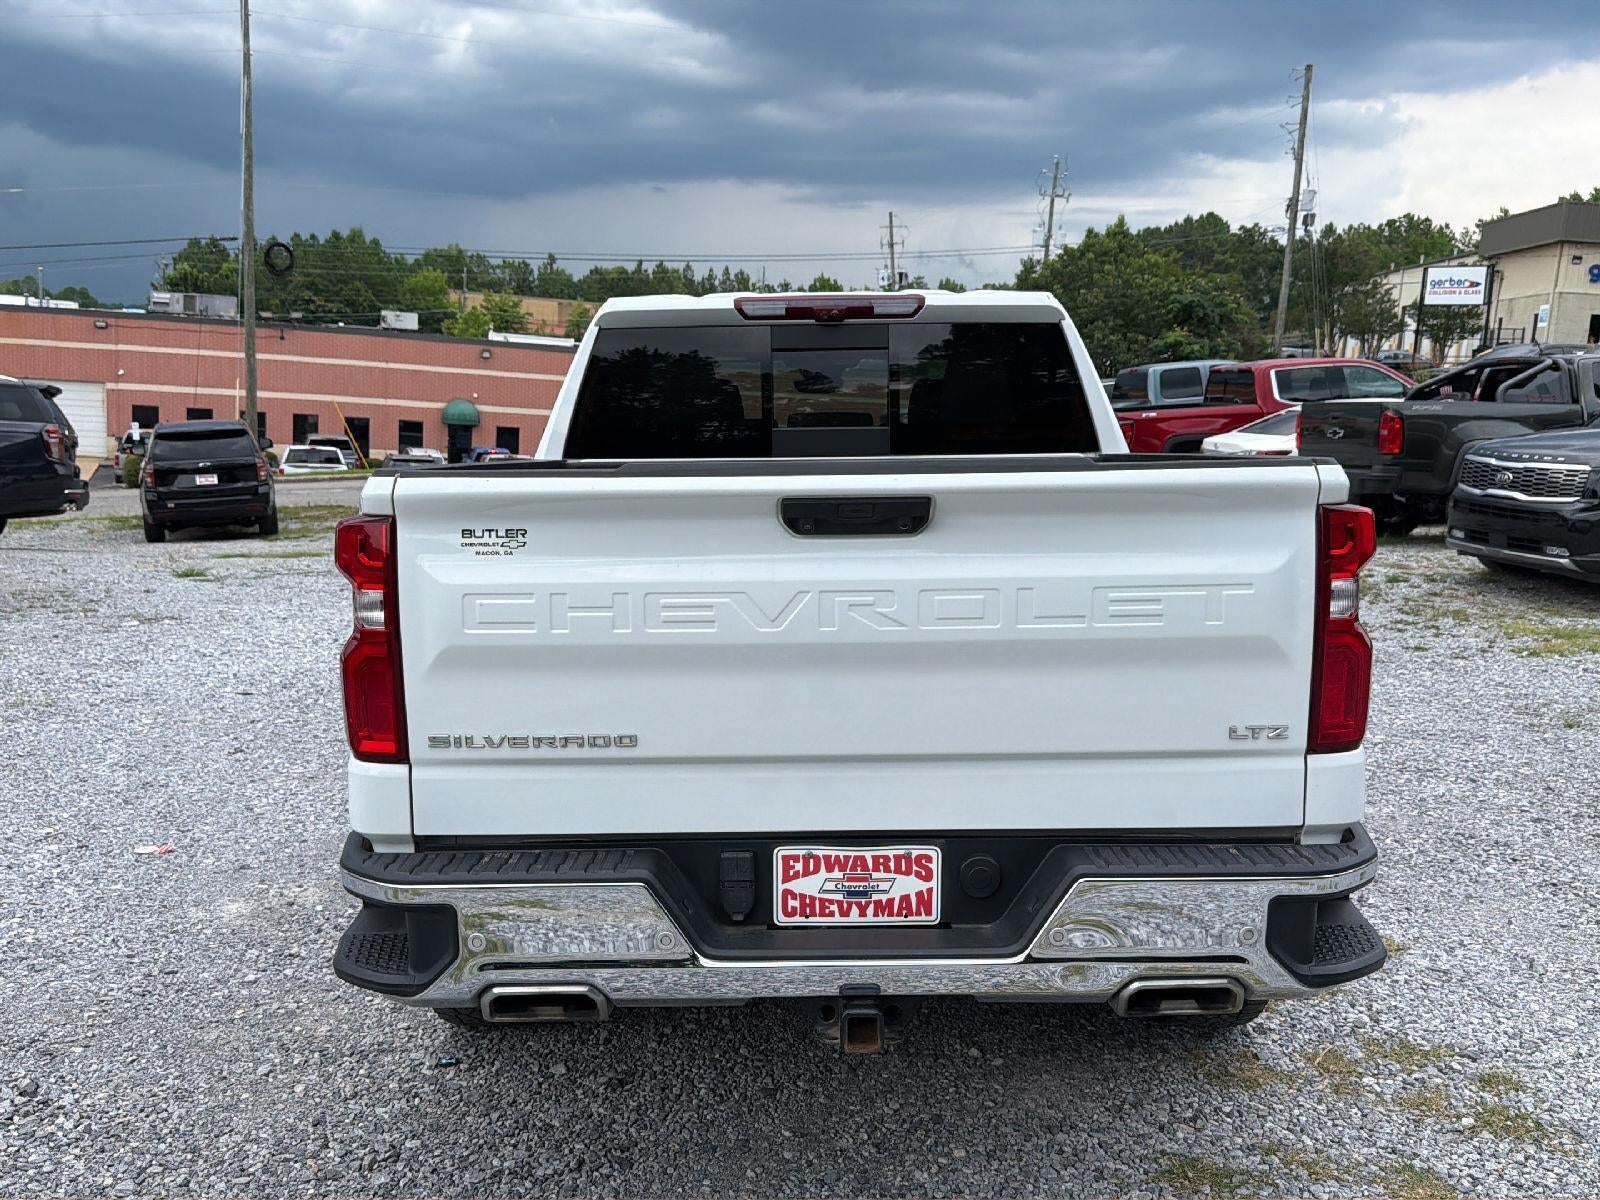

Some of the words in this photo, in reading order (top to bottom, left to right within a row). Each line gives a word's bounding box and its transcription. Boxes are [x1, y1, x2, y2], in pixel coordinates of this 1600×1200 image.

[1429, 276, 1470, 289] gerber
[461, 528, 528, 539] BUTLER
[462, 583, 1255, 633] CHEVROLET
[1228, 724, 1290, 740] LTZ
[427, 733, 638, 749] SILVERADO
[781, 853, 934, 885] EDWARDS
[834, 882, 880, 891] Chevrolet
[781, 886, 934, 918] CHEVYMAN
